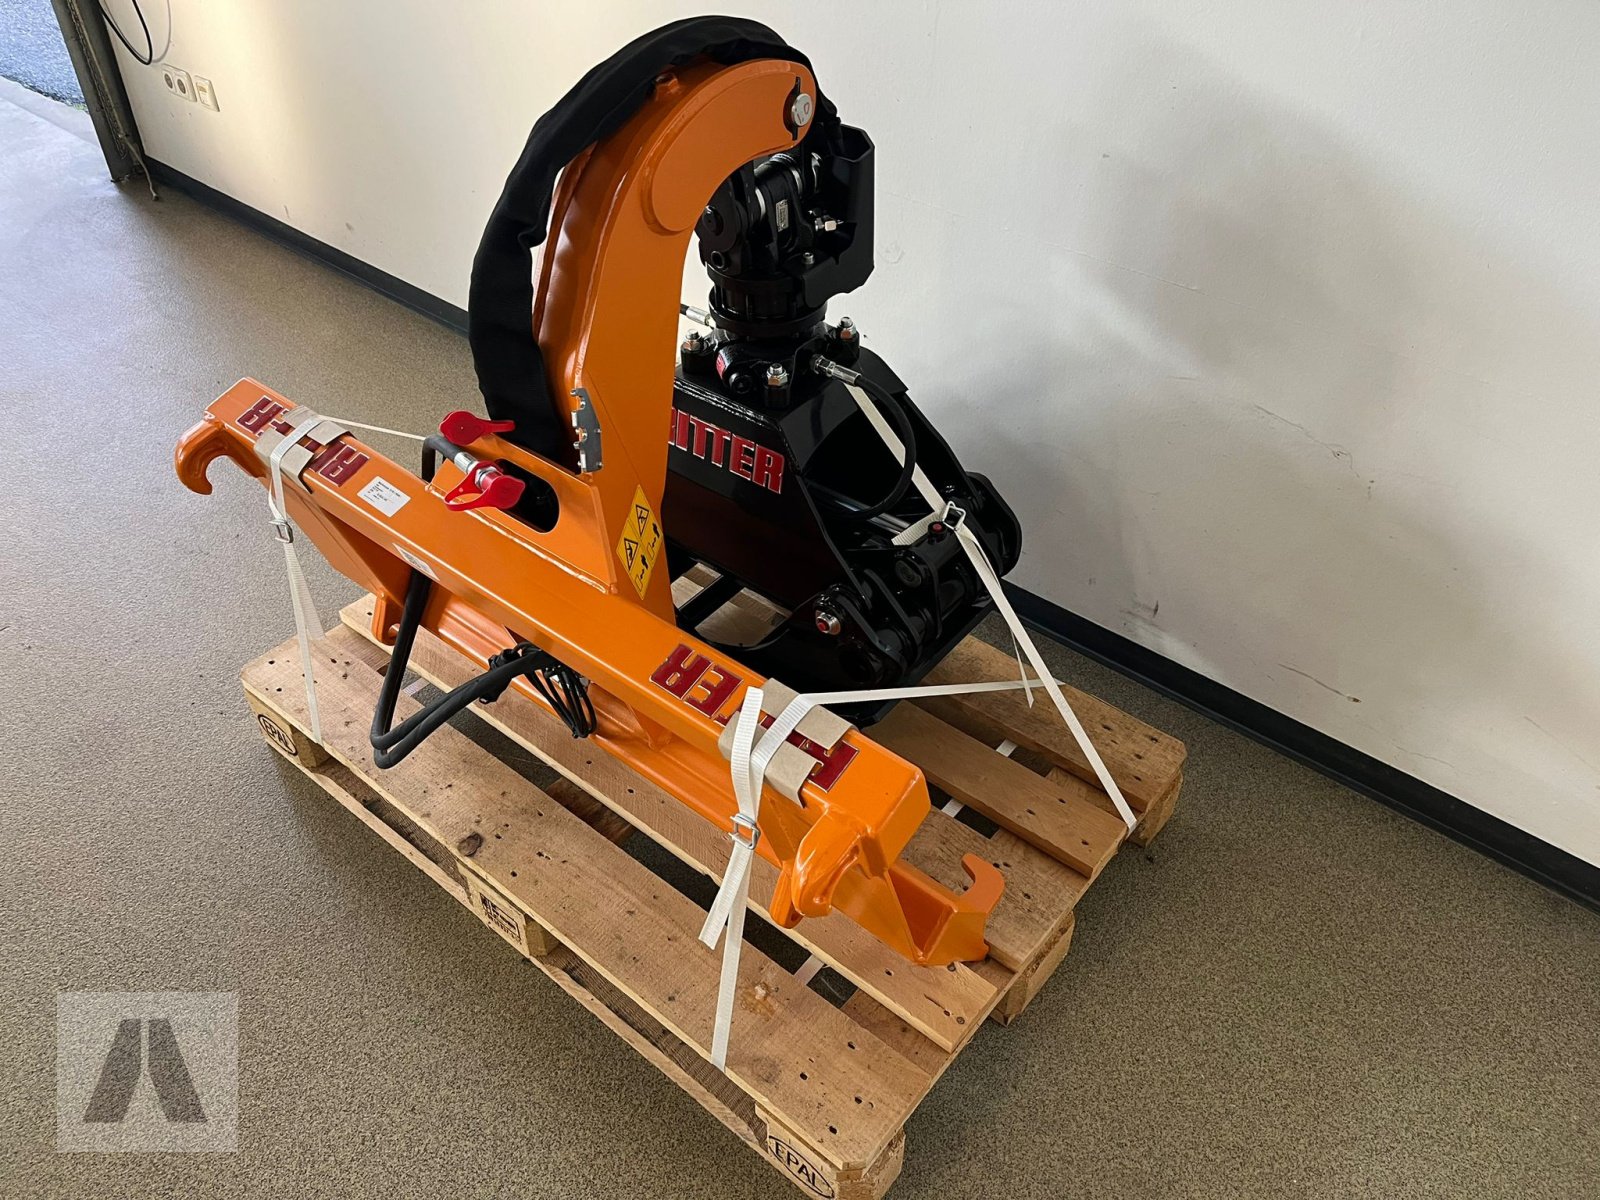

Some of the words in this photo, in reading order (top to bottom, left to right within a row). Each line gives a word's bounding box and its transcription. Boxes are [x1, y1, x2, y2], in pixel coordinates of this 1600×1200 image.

[235, 395, 370, 487] RIR
[668, 406, 785, 494] ITTER
[649, 643, 859, 792] RER
[775, 1141, 823, 1193] EPAL
